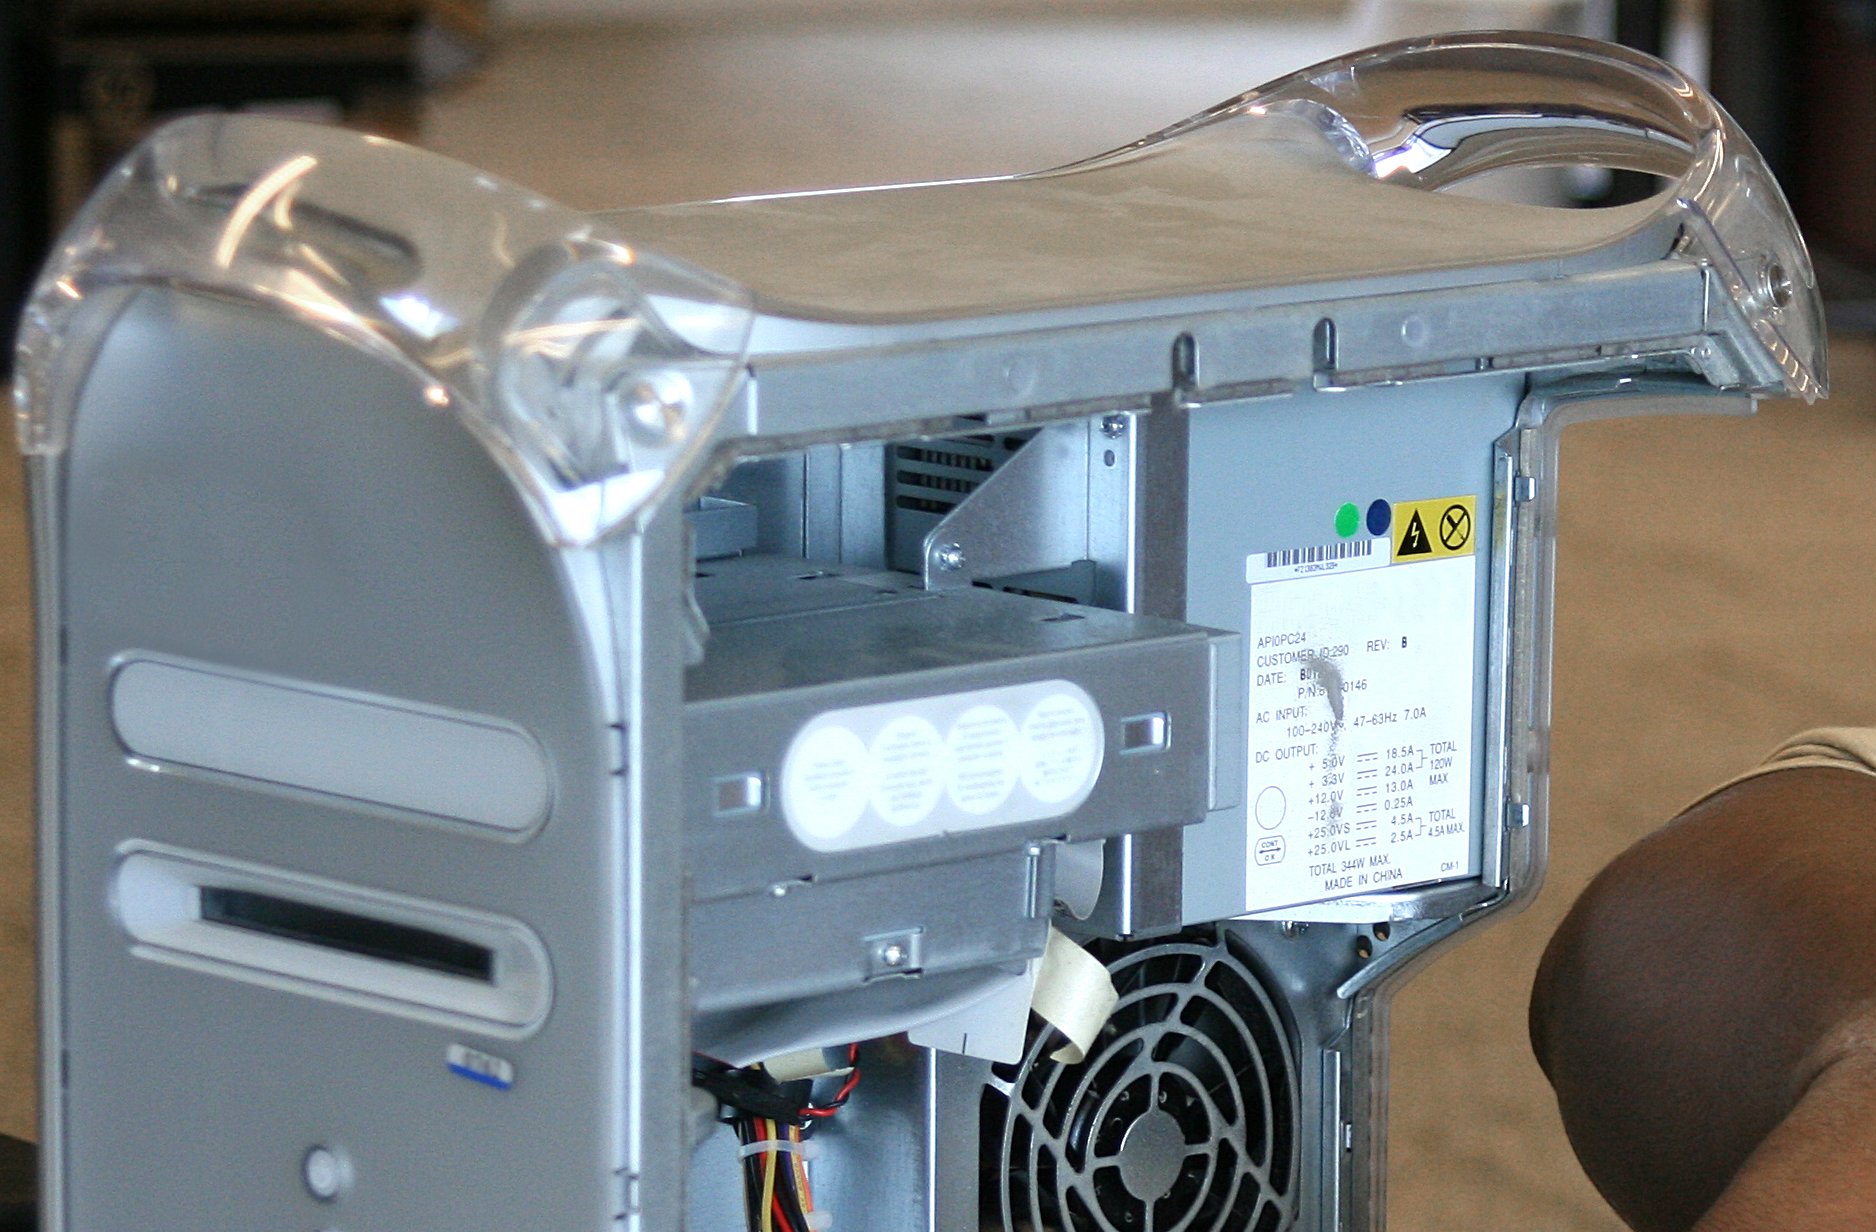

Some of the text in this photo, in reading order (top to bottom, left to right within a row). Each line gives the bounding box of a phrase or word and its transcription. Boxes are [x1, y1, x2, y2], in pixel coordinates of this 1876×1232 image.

[1367, 639, 1389, 652] REV:
[1257, 650, 1314, 667] CUSTOMER
[1257, 672, 1287, 686] DATE:
[1256, 705, 1308, 723] AC INPUT:
[1353, 713, 1397, 727] 47-63Hz
[1404, 707, 1426, 721] 7.0A
[1256, 744, 1318, 763] DC OUTPUT:
[1430, 741, 1457, 754] TOTAL
[1322, 756, 1345, 769] 5.0V
[1386, 745, 1414, 759] 18.5A
[1430, 757, 1452, 770] 120W
[1322, 773, 1344, 787] 3.3V
[1385, 762, 1414, 777] 24.0A
[1429, 773, 1449, 786] MAX
[1309, 780, 1413, 805] +12.0V 13.0A
[1384, 796, 1413, 810] 0.25A
[1428, 808, 1456, 822] TOTAL
[1308, 813, 1413, 839] +25.0VS 4.5A
[1428, 825, 1445, 838] 4.5A
[1307, 830, 1413, 856] +25.0VL 2.5A
[1309, 863, 1337, 877] TOTAL
[1341, 859, 1365, 873] 344W
[1441, 861, 1459, 872] CM-1
[1325, 869, 1403, 891] MADE IN CHINA
